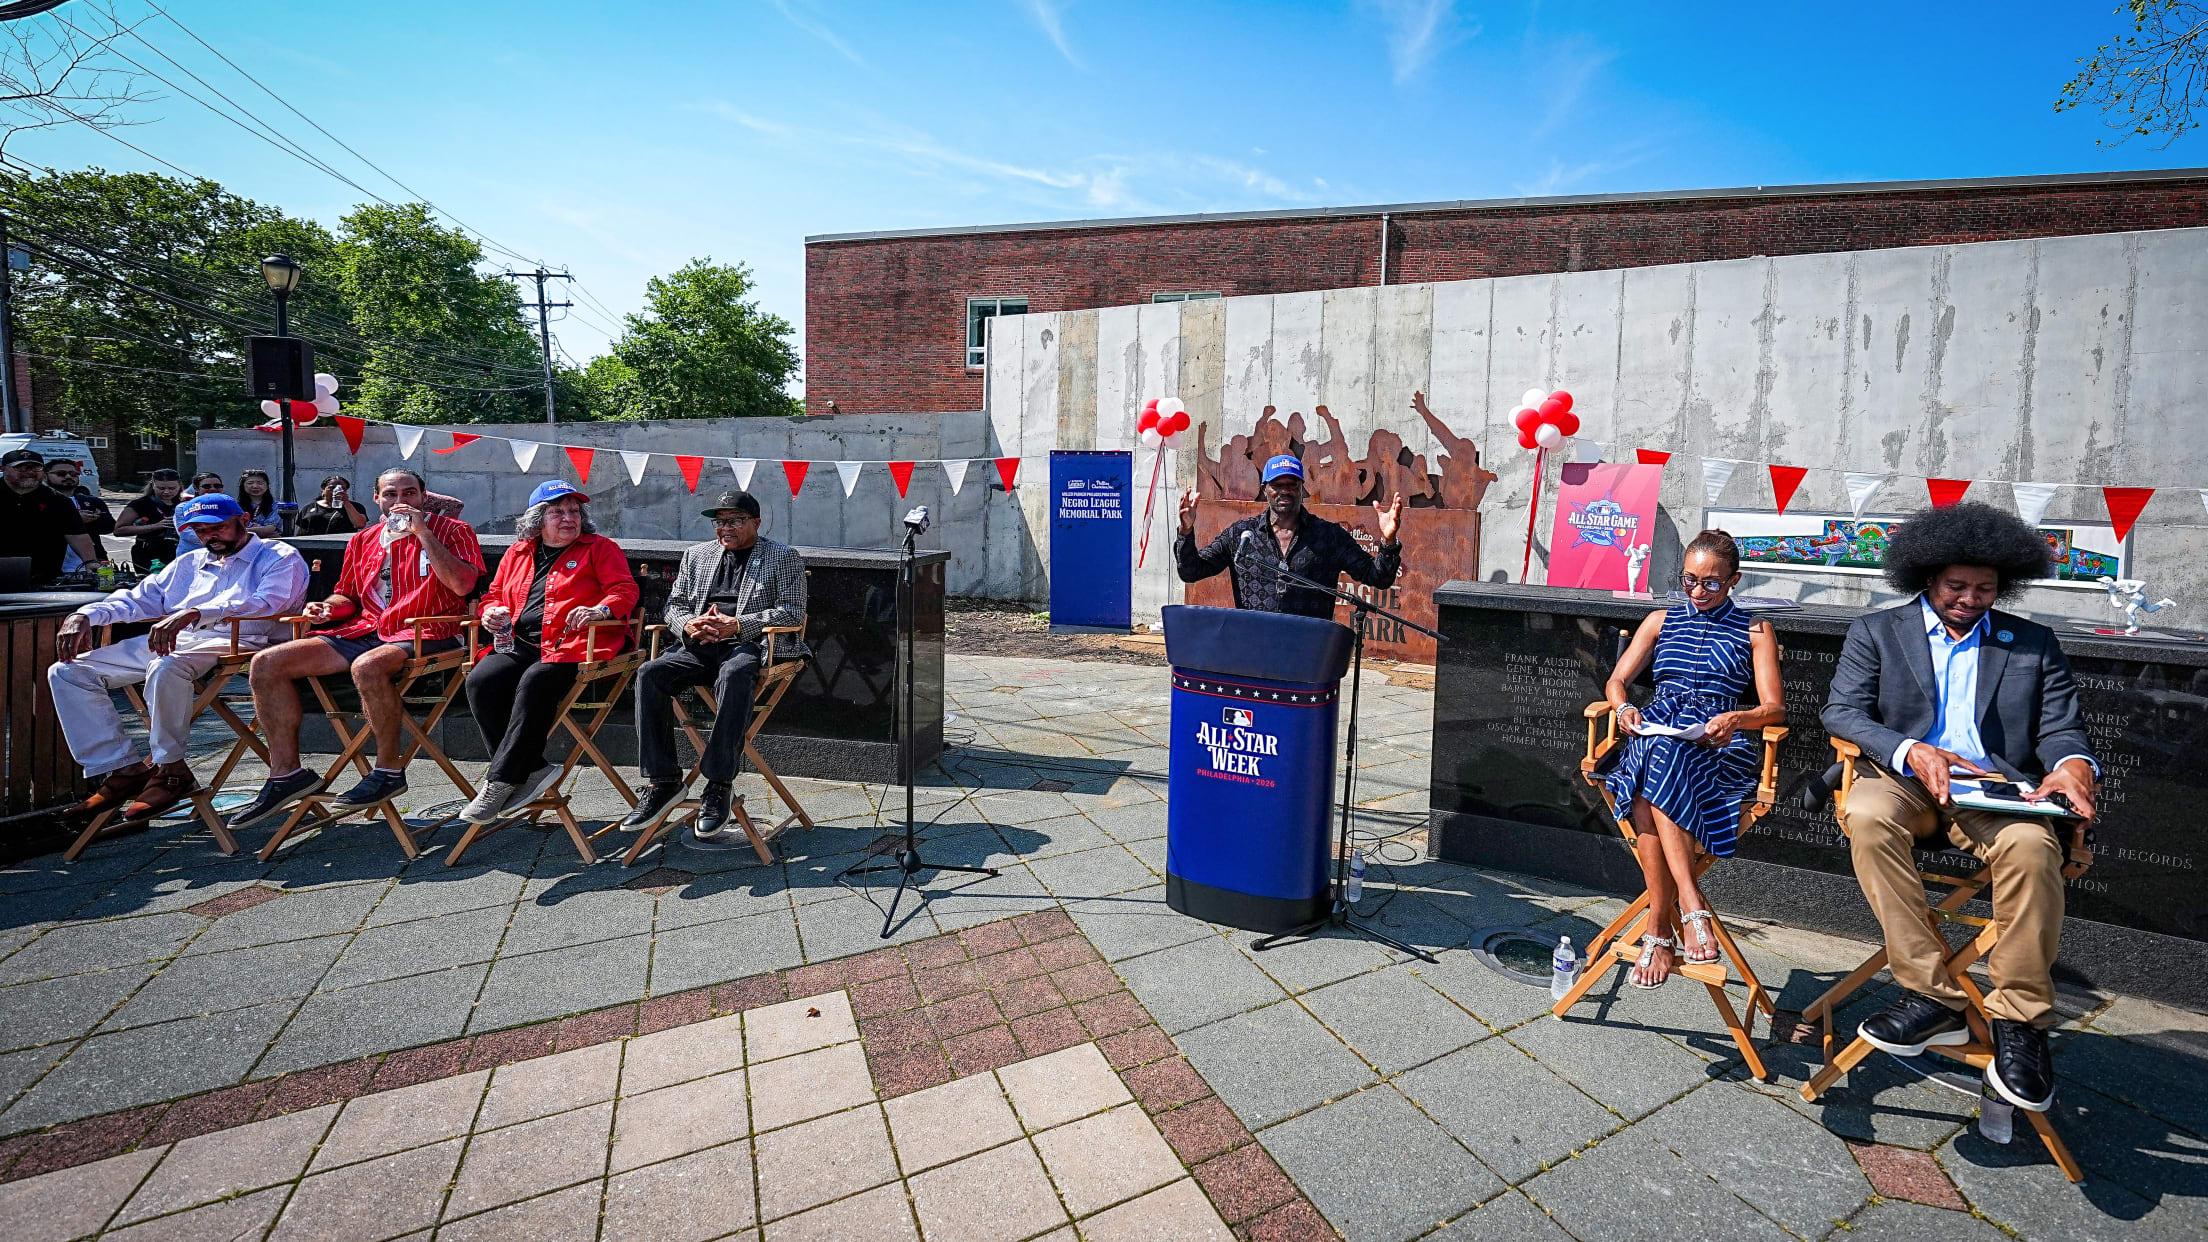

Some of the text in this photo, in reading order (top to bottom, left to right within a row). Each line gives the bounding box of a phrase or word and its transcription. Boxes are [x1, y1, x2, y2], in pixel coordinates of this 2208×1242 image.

[1062, 497, 1120, 508] NEGRO LEAGUE
[1060, 508, 1122, 518] MEMORIAL PARK
[1568, 512, 1638, 528] ALL STAR GAME
[1505, 653, 1581, 668] FRANK AUSTIN
[1817, 652, 1834, 662] TO
[1506, 664, 1579, 678] GENE BENSON
[1542, 678, 1578, 688] BOONE
[2078, 677, 2124, 692] STARS
[1501, 684, 1582, 700] BARNEY BROWN
[1786, 692, 1819, 703] DEAN
[1533, 696, 1571, 708] CARTER
[1536, 708, 1568, 719] CASEY
[2082, 712, 2129, 727] ARRIS
[1487, 722, 1520, 734] OSCAR
[1513, 716, 1566, 729] BILL CASH
[2086, 724, 2122, 738] ONES
[1196, 722, 1278, 756] ALL STAR
[1502, 734, 1576, 750] HOMER CURRY
[1207, 746, 1262, 776] WEEK
[1196, 768, 1276, 788] PHILADELPHIA 2026
[2096, 790, 2126, 803] ALM
[1780, 828, 1833, 846] LEAGUE
[1922, 852, 1982, 870] PLAYER
[2118, 847, 2193, 870] RECORDS
